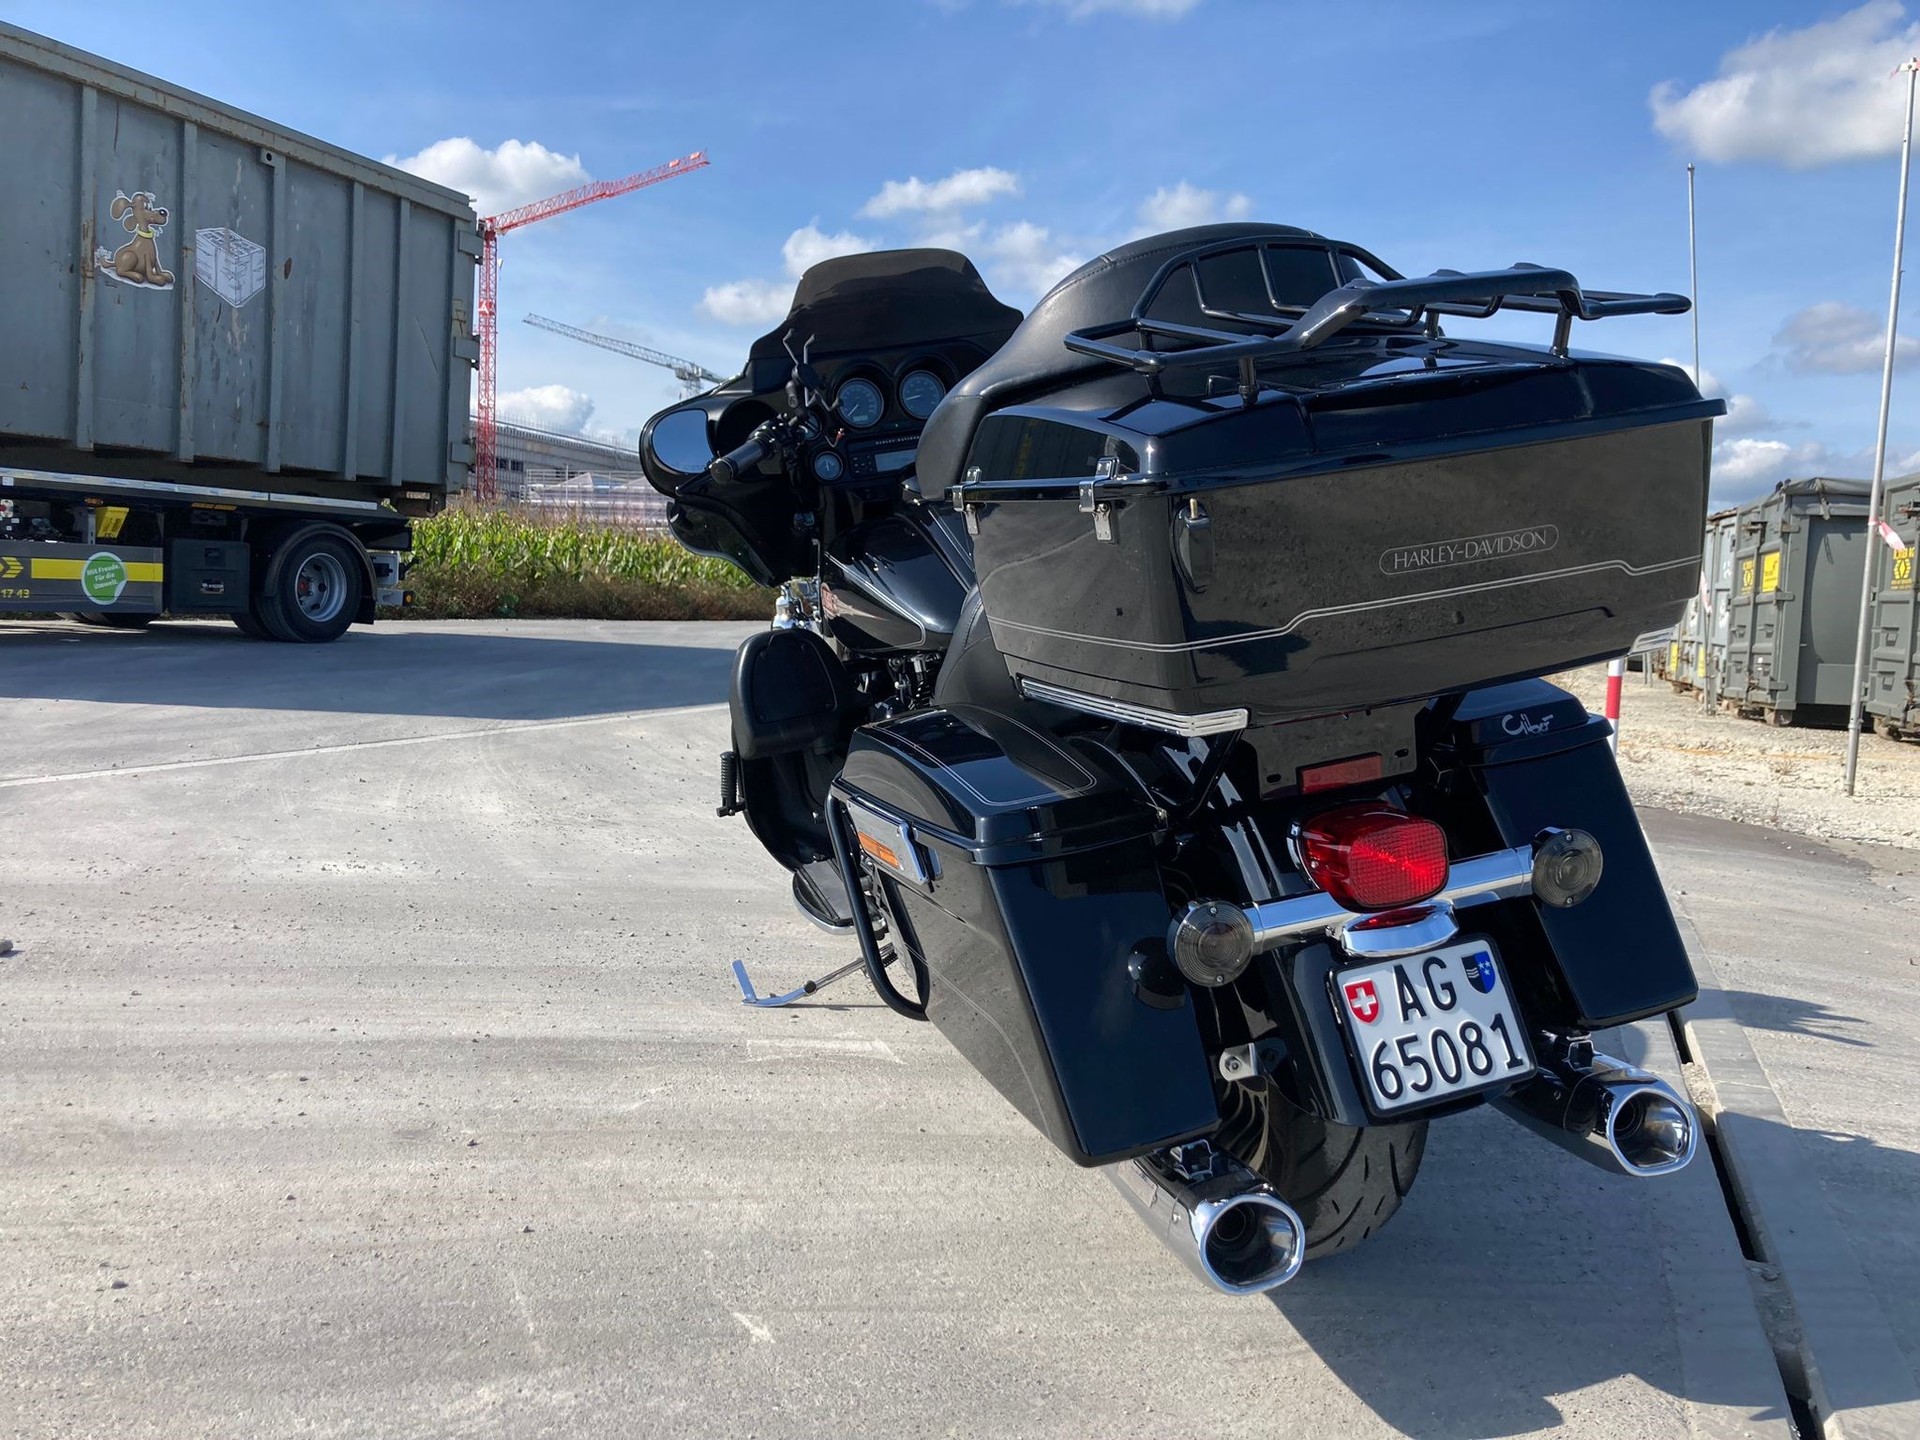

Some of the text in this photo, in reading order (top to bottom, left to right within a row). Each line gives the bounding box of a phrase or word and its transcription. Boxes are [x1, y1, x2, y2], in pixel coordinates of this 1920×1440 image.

[1394, 530, 1547, 569] HARLEY-DAVIDSON
[1392, 956, 1458, 1023] AG
[1372, 1012, 1524, 1100] 65081
